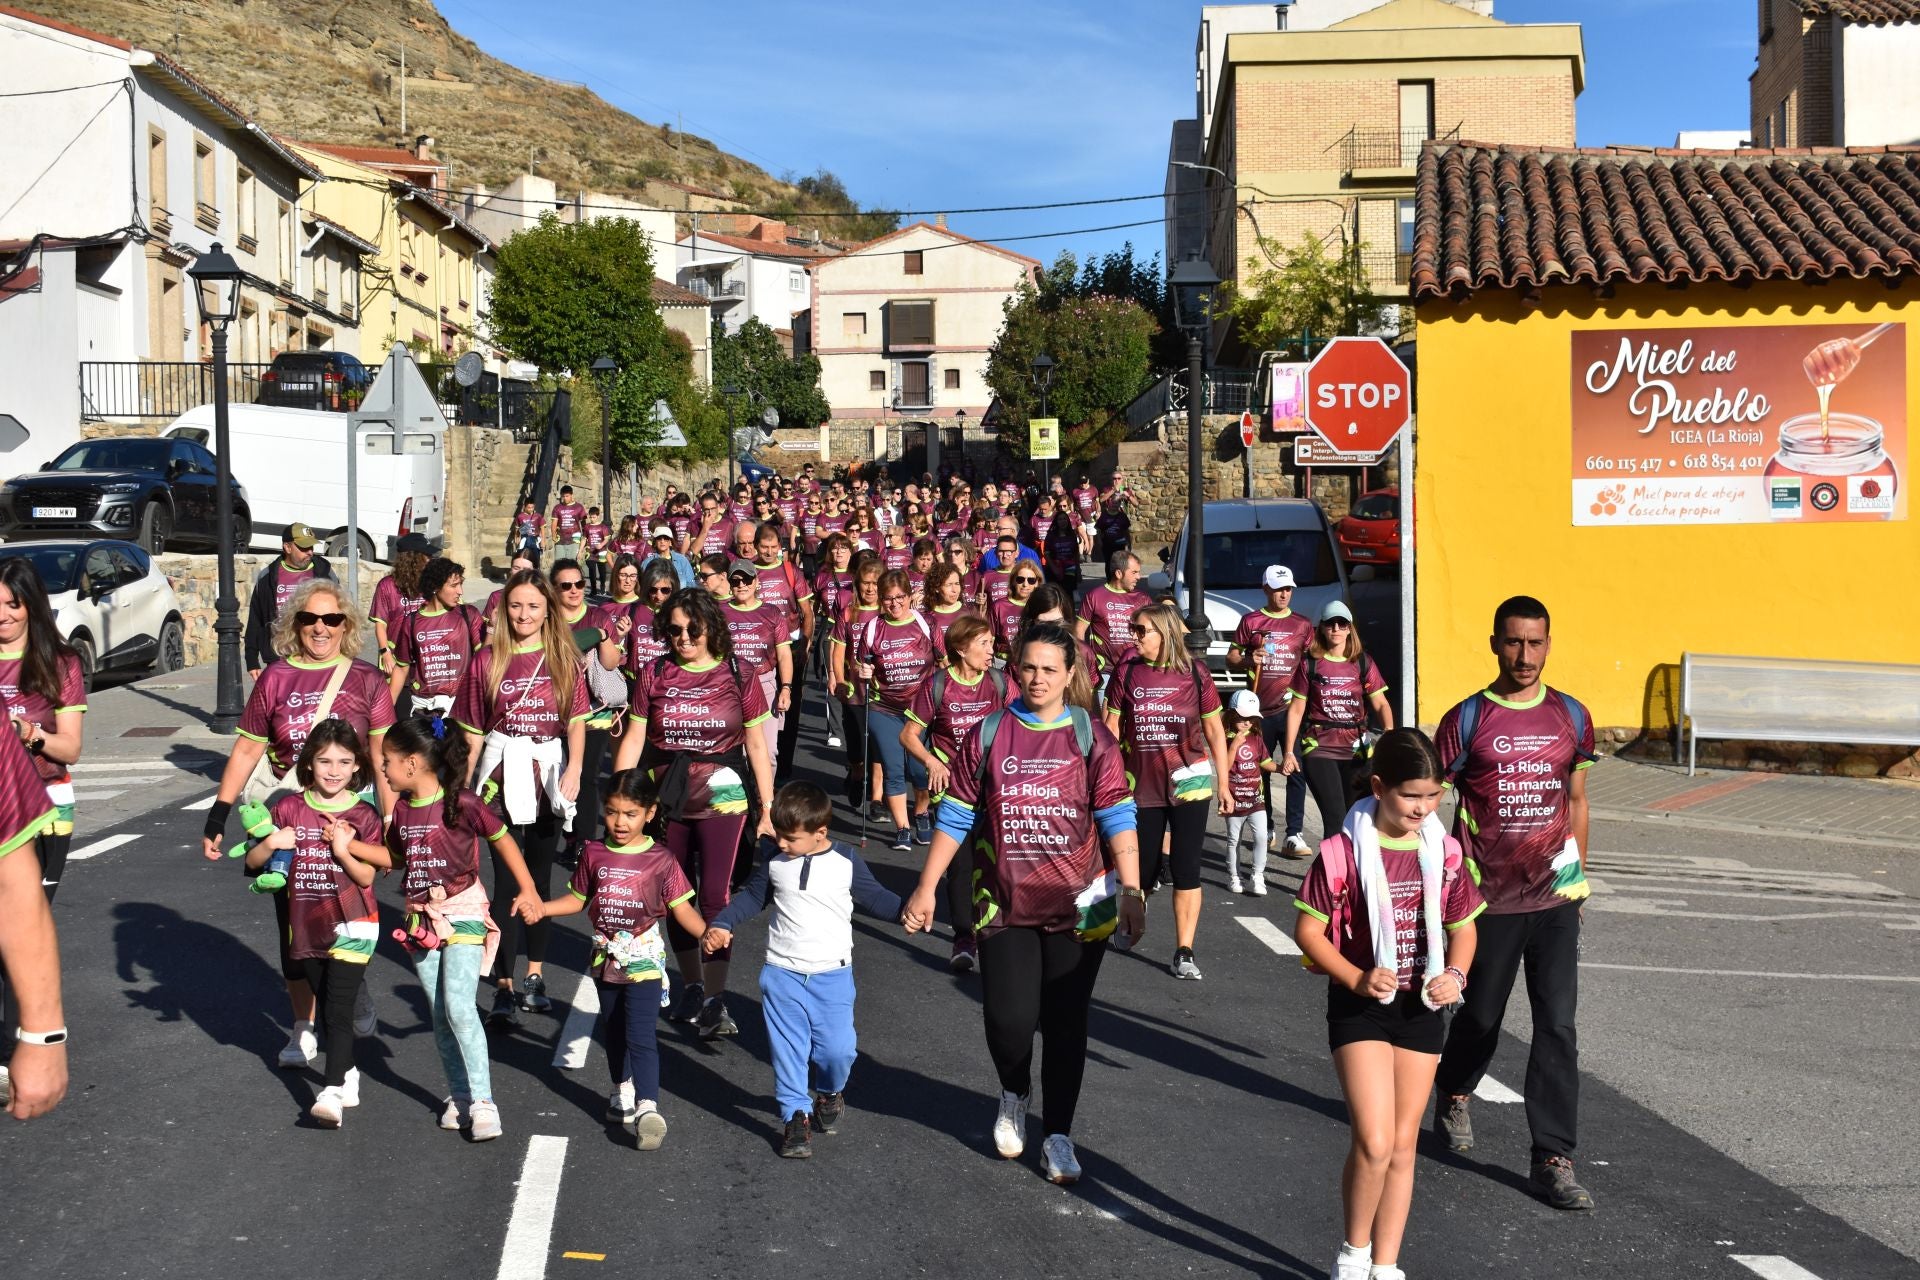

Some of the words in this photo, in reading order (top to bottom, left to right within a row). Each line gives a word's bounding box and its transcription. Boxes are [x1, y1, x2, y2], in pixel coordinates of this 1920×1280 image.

[1586, 337, 1694, 393] Miel
[1701, 350, 1737, 372] del
[1317, 383, 1401, 408] STOP
[1629, 379, 1771, 433] Pueblo
[1670, 430, 1703, 444] IGEA
[1706, 430, 1725, 446] (La
[1729, 429, 1764, 446] Rioja)
[1586, 456, 1613, 470] 660
[1618, 458, 1636, 473] 115
[1640, 458, 1662, 472] 417
[1684, 454, 1708, 469] 618
[1712, 454, 1735, 471] 854
[1739, 456, 1763, 472] 401
[1633, 485, 1661, 500] Miel
[1664, 489, 1690, 503] pura
[1694, 486, 1708, 498] de
[1712, 487, 1745, 502] abeja
[1628, 504, 1675, 516] Cosecha
[1679, 507, 1721, 520] propia
[430, 644, 449, 652] Rioja
[431, 653, 460, 661] marcha
[894, 651, 913, 659] Rioja
[895, 659, 925, 668] marcha
[431, 669, 456, 677] cáncer
[886, 667, 910, 675] contra
[1332, 689, 1352, 697] Rioja
[664, 704, 676, 713] La
[680, 704, 709, 715] Rioja
[1147, 703, 1173, 712] Rioja
[288, 715, 305, 724] La
[518, 711, 559, 721] marcha
[1134, 715, 1145, 723] En
[1148, 714, 1186, 723] marcha
[663, 717, 676, 727] En
[679, 718, 726, 728] marcha
[289, 729, 307, 740] En
[665, 729, 701, 737] contra
[1136, 733, 1145, 741] el
[1146, 732, 1178, 740] cáncer
[678, 736, 716, 747] cáncer
[1240, 762, 1256, 770] IGEA
[1498, 763, 1515, 774] La
[1518, 761, 1552, 775] Rioja
[1498, 780, 1515, 791] En
[1519, 778, 1562, 790] marcha
[1001, 784, 1018, 796] La
[1022, 783, 1059, 799] Rioja
[1498, 793, 1542, 804] contra
[1002, 803, 1019, 815] En
[1023, 804, 1077, 818] marcha
[1499, 806, 1512, 817] el
[1515, 805, 1555, 817] cáncer
[1002, 817, 1049, 830] contra
[1003, 831, 1017, 844] el
[1021, 830, 1070, 844] cáncer
[296, 847, 306, 856] La
[309, 845, 331, 859] Rioja
[411, 845, 432, 855] Rioa
[309, 862, 343, 872] marcha
[295, 871, 327, 880] contra
[295, 881, 304, 889] el
[610, 885, 632, 896] Rioja
[608, 898, 644, 909] marcha
[1394, 908, 1425, 922] Rioja
[1397, 929, 1426, 940] marc
[1396, 941, 1418, 954] ntra
[1397, 956, 1427, 968] cánce
